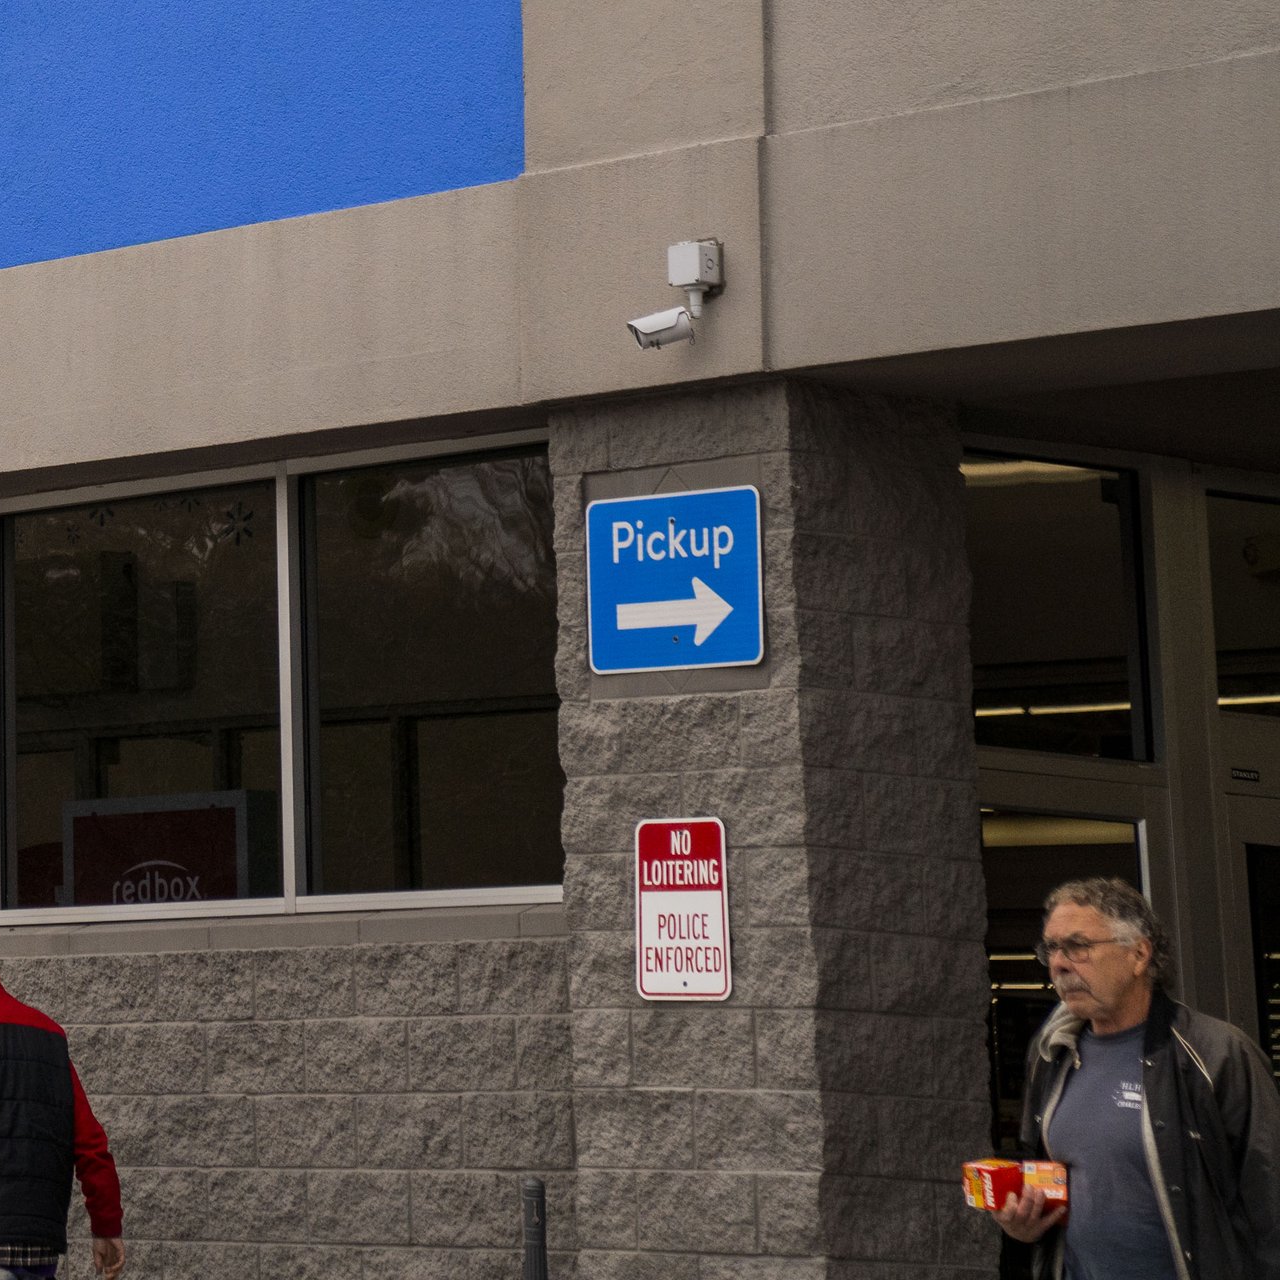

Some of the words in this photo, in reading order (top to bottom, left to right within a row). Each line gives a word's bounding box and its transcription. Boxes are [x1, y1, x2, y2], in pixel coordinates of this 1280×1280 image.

[612, 516, 734, 569] Pickup
[670, 829, 691, 855] NO
[643, 860, 719, 886] LOITERING
[112, 870, 202, 905] redbox
[658, 913, 710, 940] POLICE
[645, 946, 722, 973] ENFORCED
